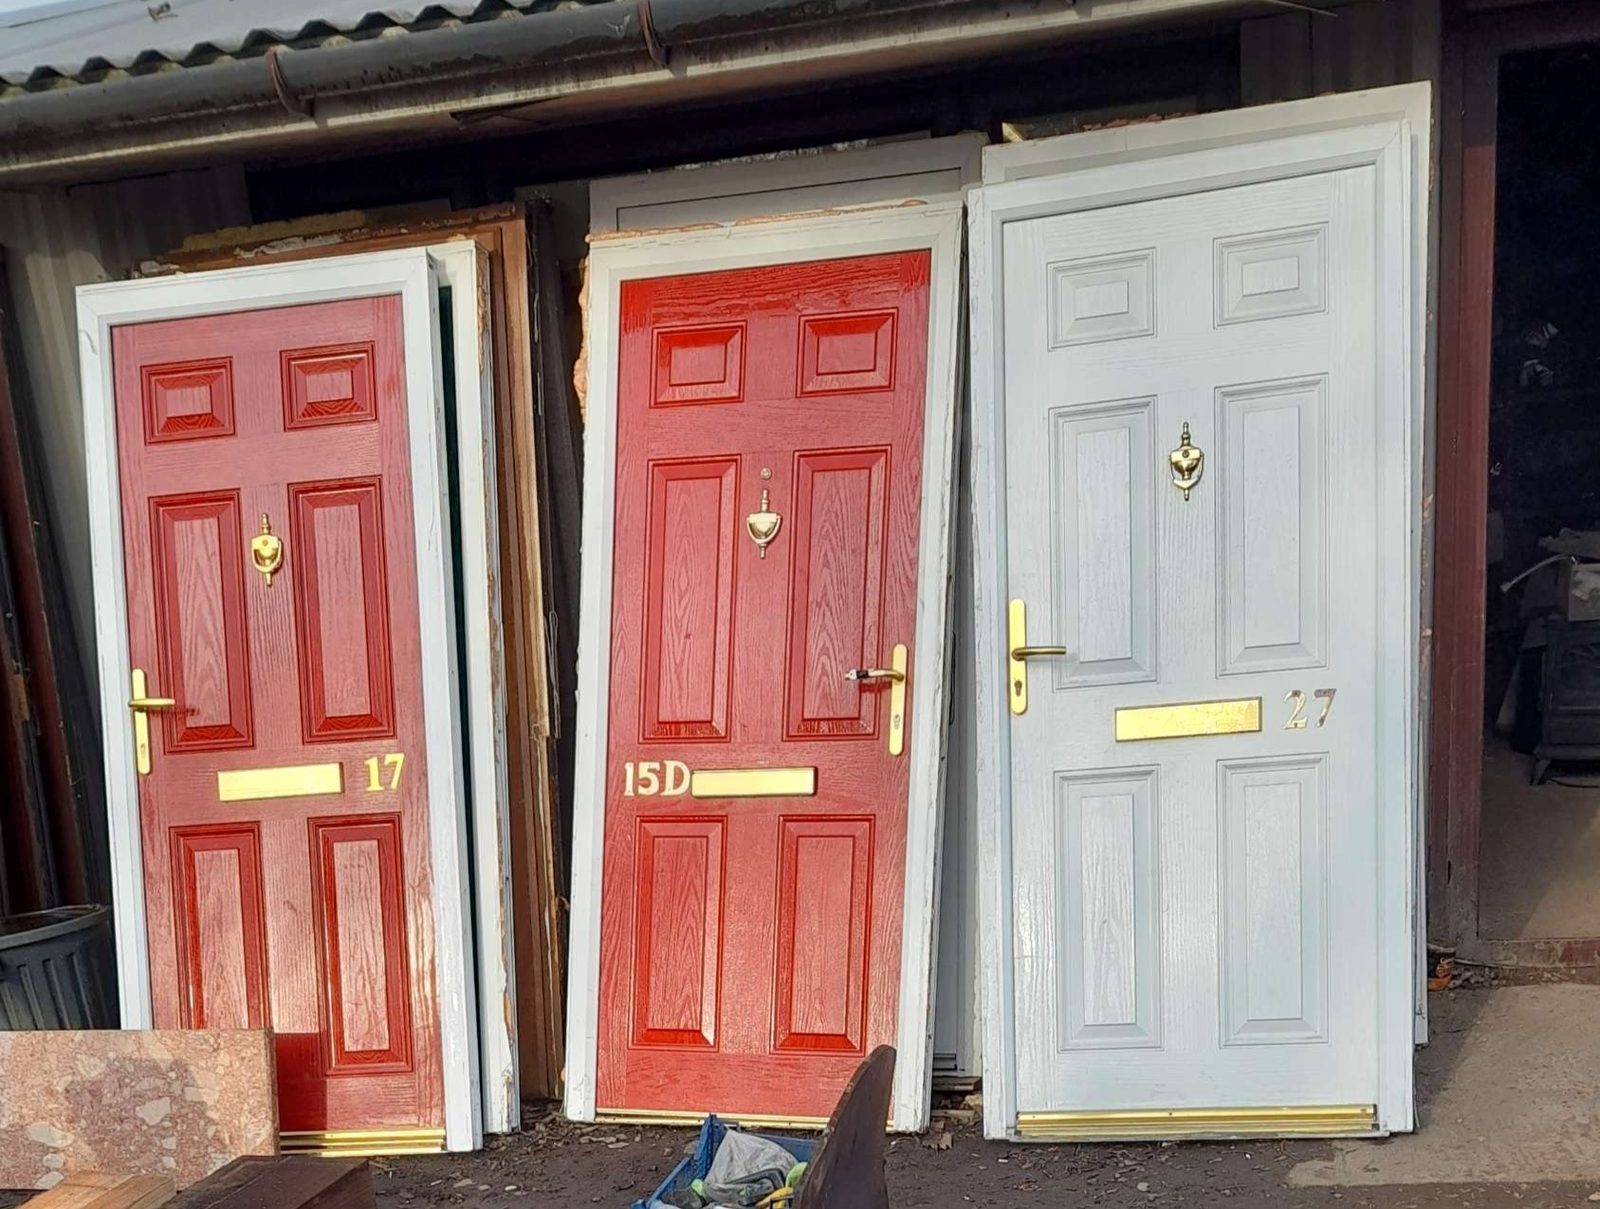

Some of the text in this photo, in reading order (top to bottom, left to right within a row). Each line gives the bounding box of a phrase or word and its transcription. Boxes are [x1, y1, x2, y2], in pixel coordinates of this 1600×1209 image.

[1283, 688, 1337, 729] 27
[364, 753, 404, 791] 17
[624, 760, 690, 796] 15D
